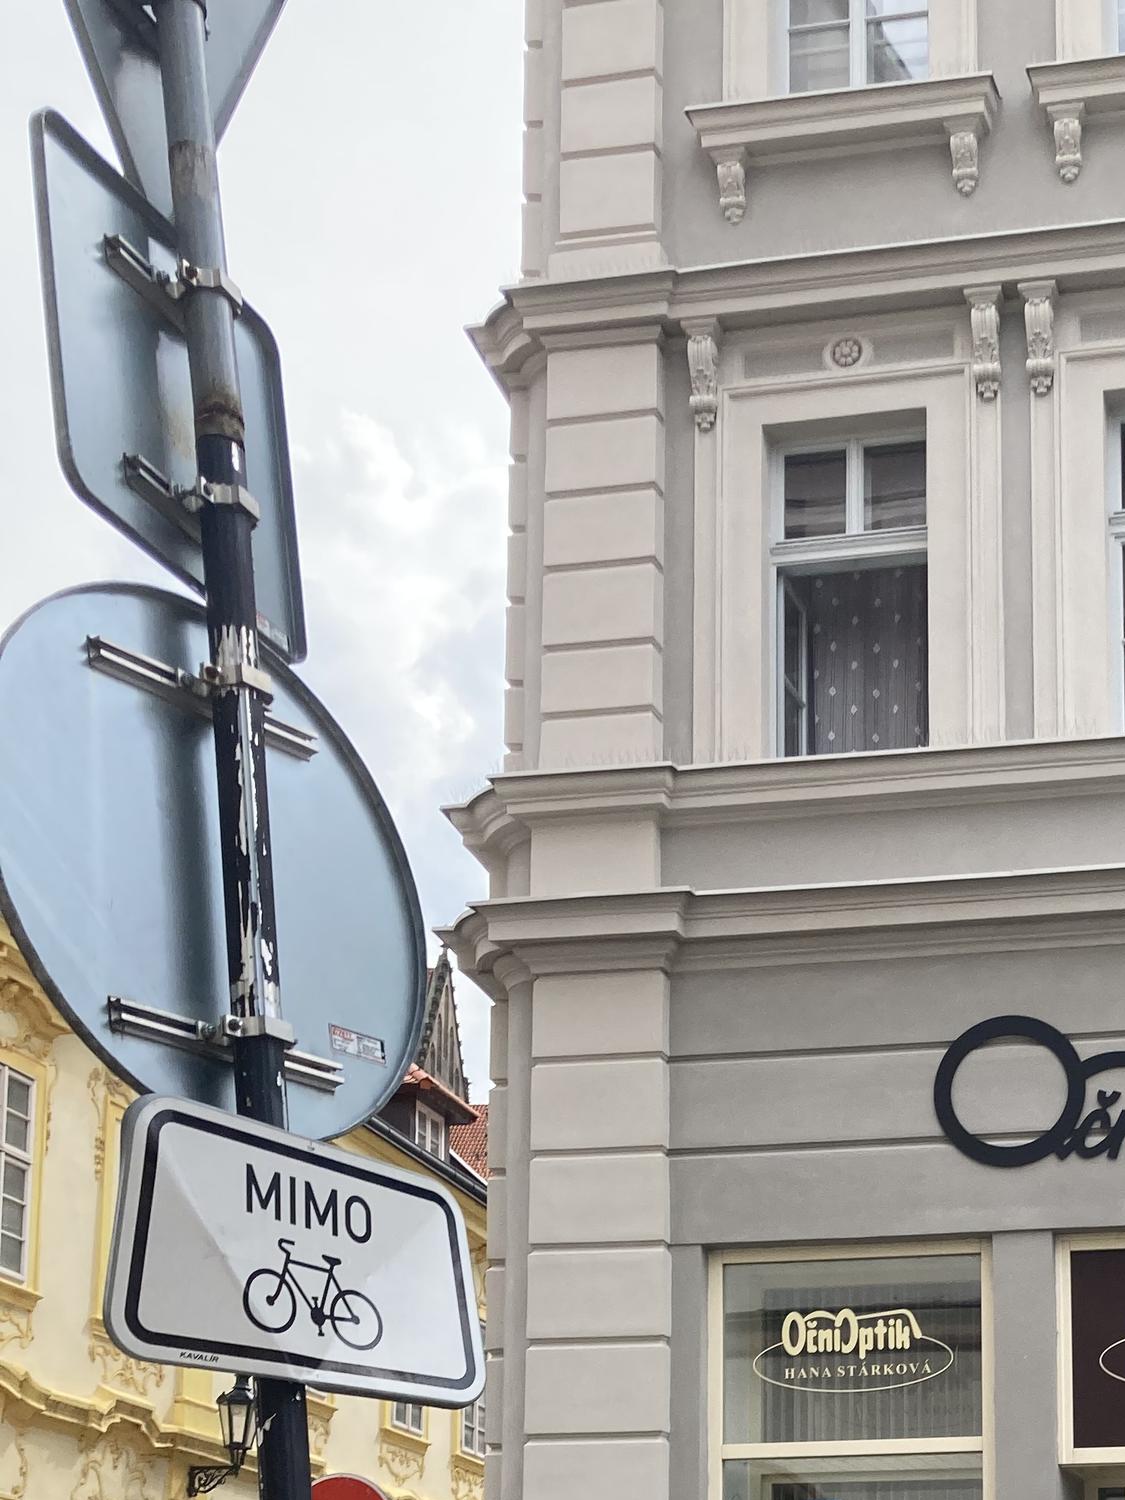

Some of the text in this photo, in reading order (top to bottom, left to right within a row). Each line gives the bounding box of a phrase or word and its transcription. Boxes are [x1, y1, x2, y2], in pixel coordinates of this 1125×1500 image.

[246, 1162, 372, 1244] MIMO
[834, 1308, 911, 1360] Optik
[784, 1359, 933, 1380] HANA STÁRKOVÁ
